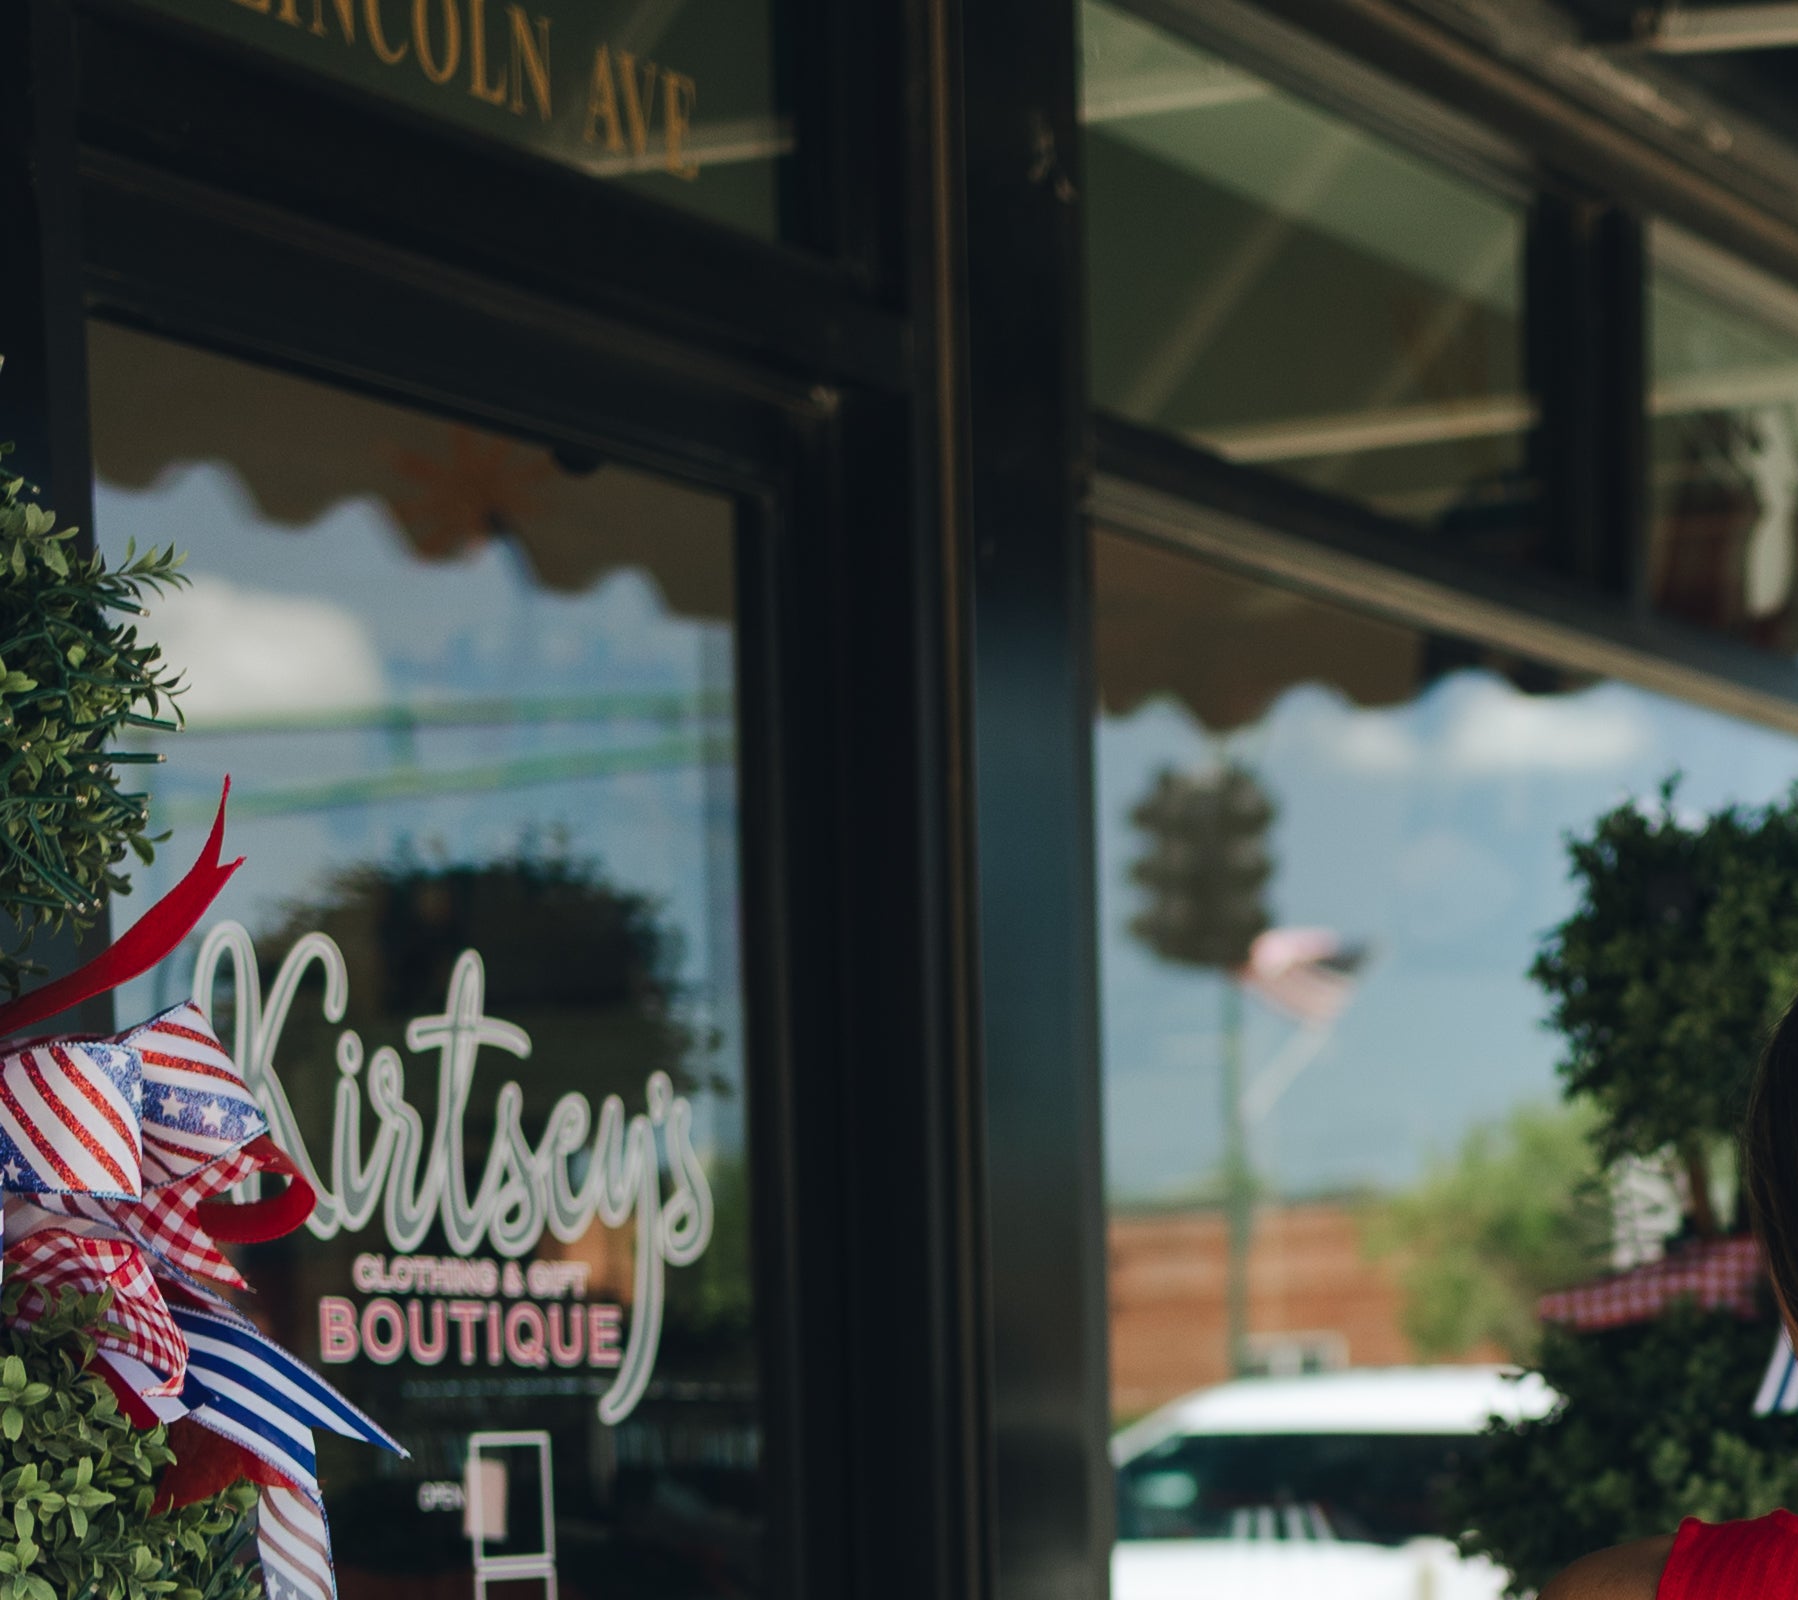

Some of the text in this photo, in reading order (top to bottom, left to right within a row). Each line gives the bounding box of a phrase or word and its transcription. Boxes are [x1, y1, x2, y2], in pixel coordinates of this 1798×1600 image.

[228, 0, 698, 182] COLN AVE
[192, 920, 714, 1426] Kirtsey's
[319, 1296, 622, 1370] BOUTIQUE
[352, 1253, 499, 1297] CLOTHING
[503, 1260, 527, 1298] &
